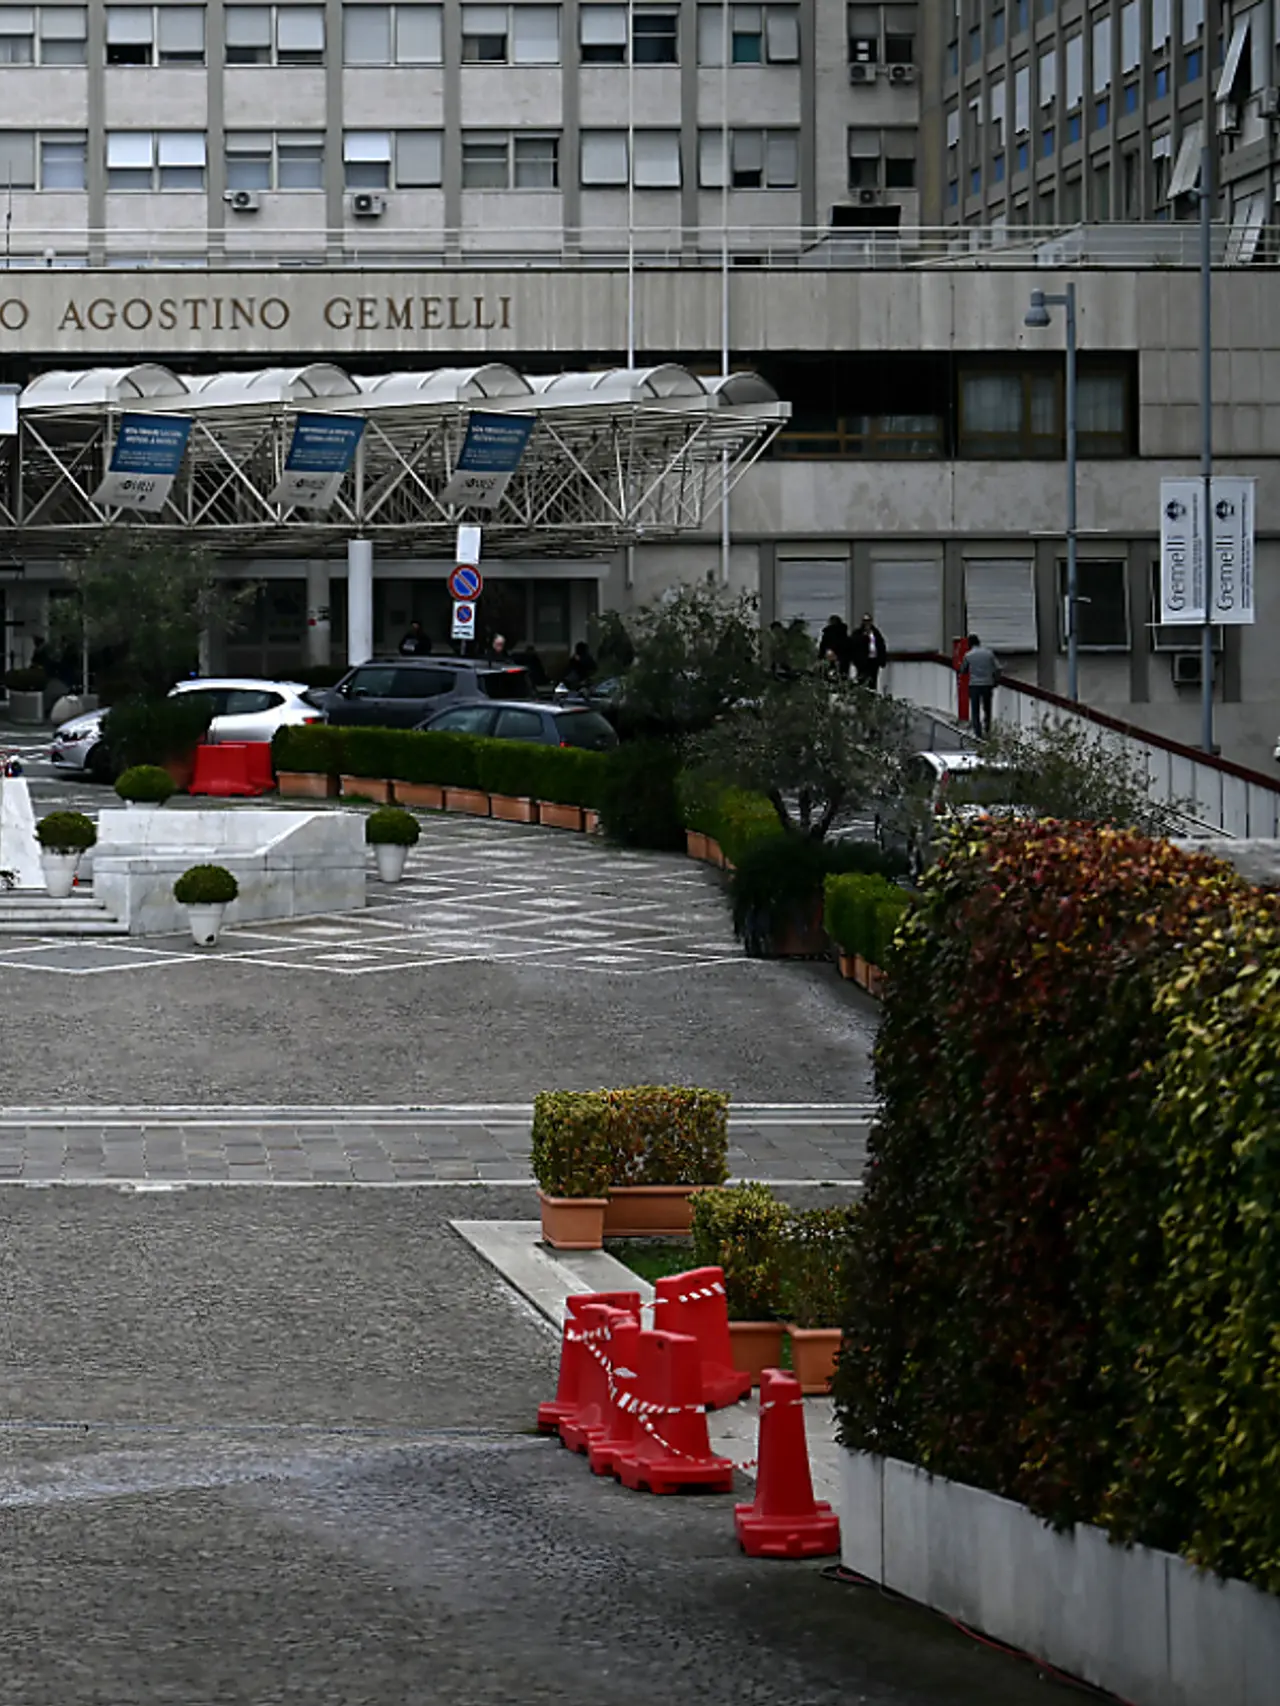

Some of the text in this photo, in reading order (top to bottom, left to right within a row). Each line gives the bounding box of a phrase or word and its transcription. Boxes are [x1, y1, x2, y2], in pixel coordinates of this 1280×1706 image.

[58, 297, 290, 332] AGOSTINO
[324, 296, 512, 332] GEMELLI
[1166, 534, 1186, 612] Gemelli
[1215, 534, 1235, 612] Gemelli
